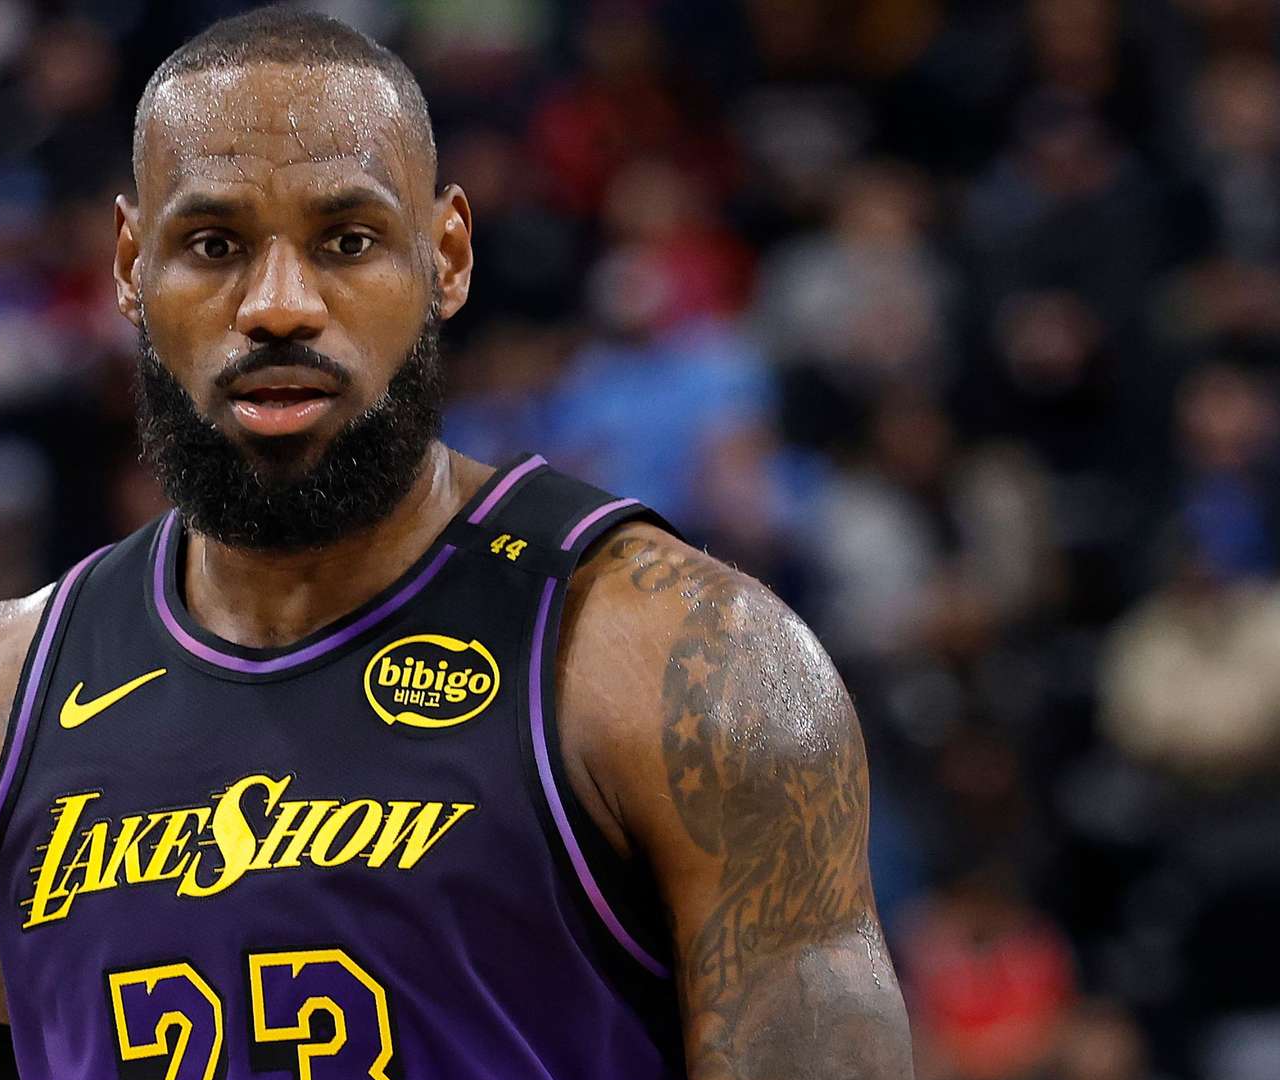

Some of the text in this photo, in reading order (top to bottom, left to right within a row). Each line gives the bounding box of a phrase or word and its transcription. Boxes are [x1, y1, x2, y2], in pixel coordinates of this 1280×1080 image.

[490, 534, 528, 561] 44
[378, 657, 491, 703] bibigo
[394, 688, 440, 707] 비비고
